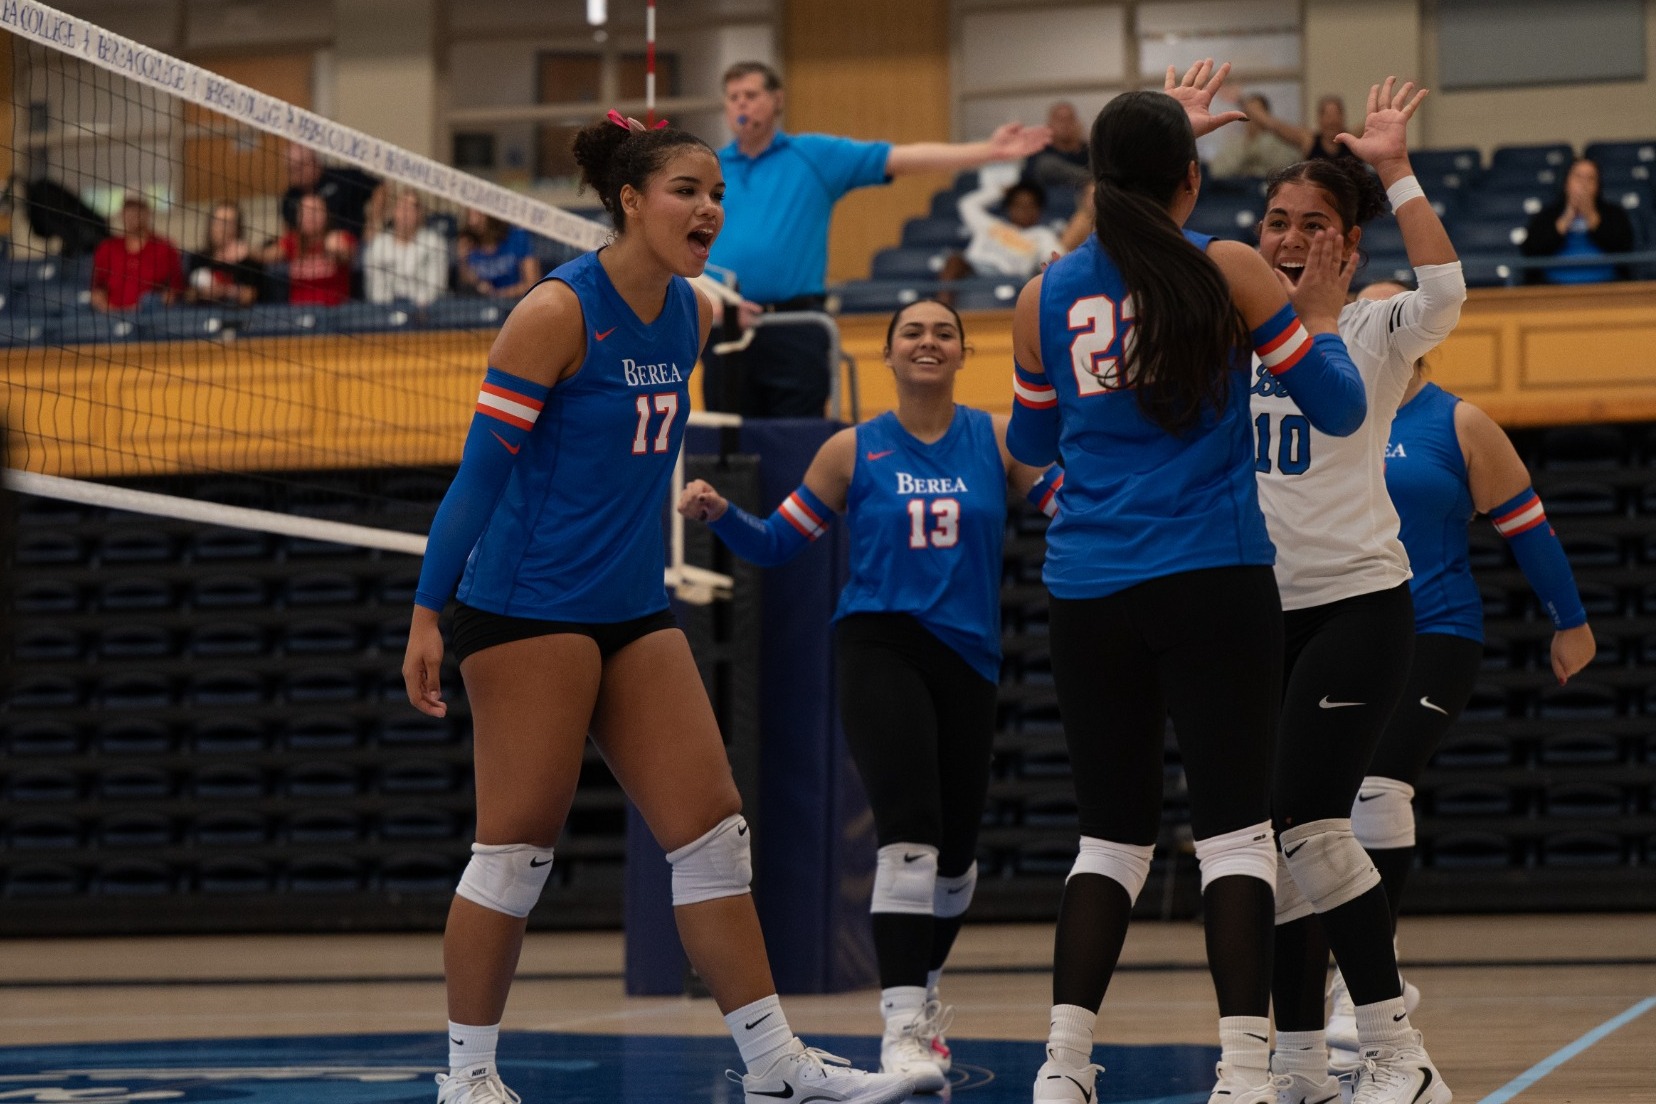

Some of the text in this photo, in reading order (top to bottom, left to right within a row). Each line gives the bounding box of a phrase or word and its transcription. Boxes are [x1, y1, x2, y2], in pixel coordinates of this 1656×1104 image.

[631, 391, 678, 455] 17
[1255, 412, 1311, 475] 10
[907, 497, 961, 549] 13
[471, 1067, 487, 1077] NIKE
